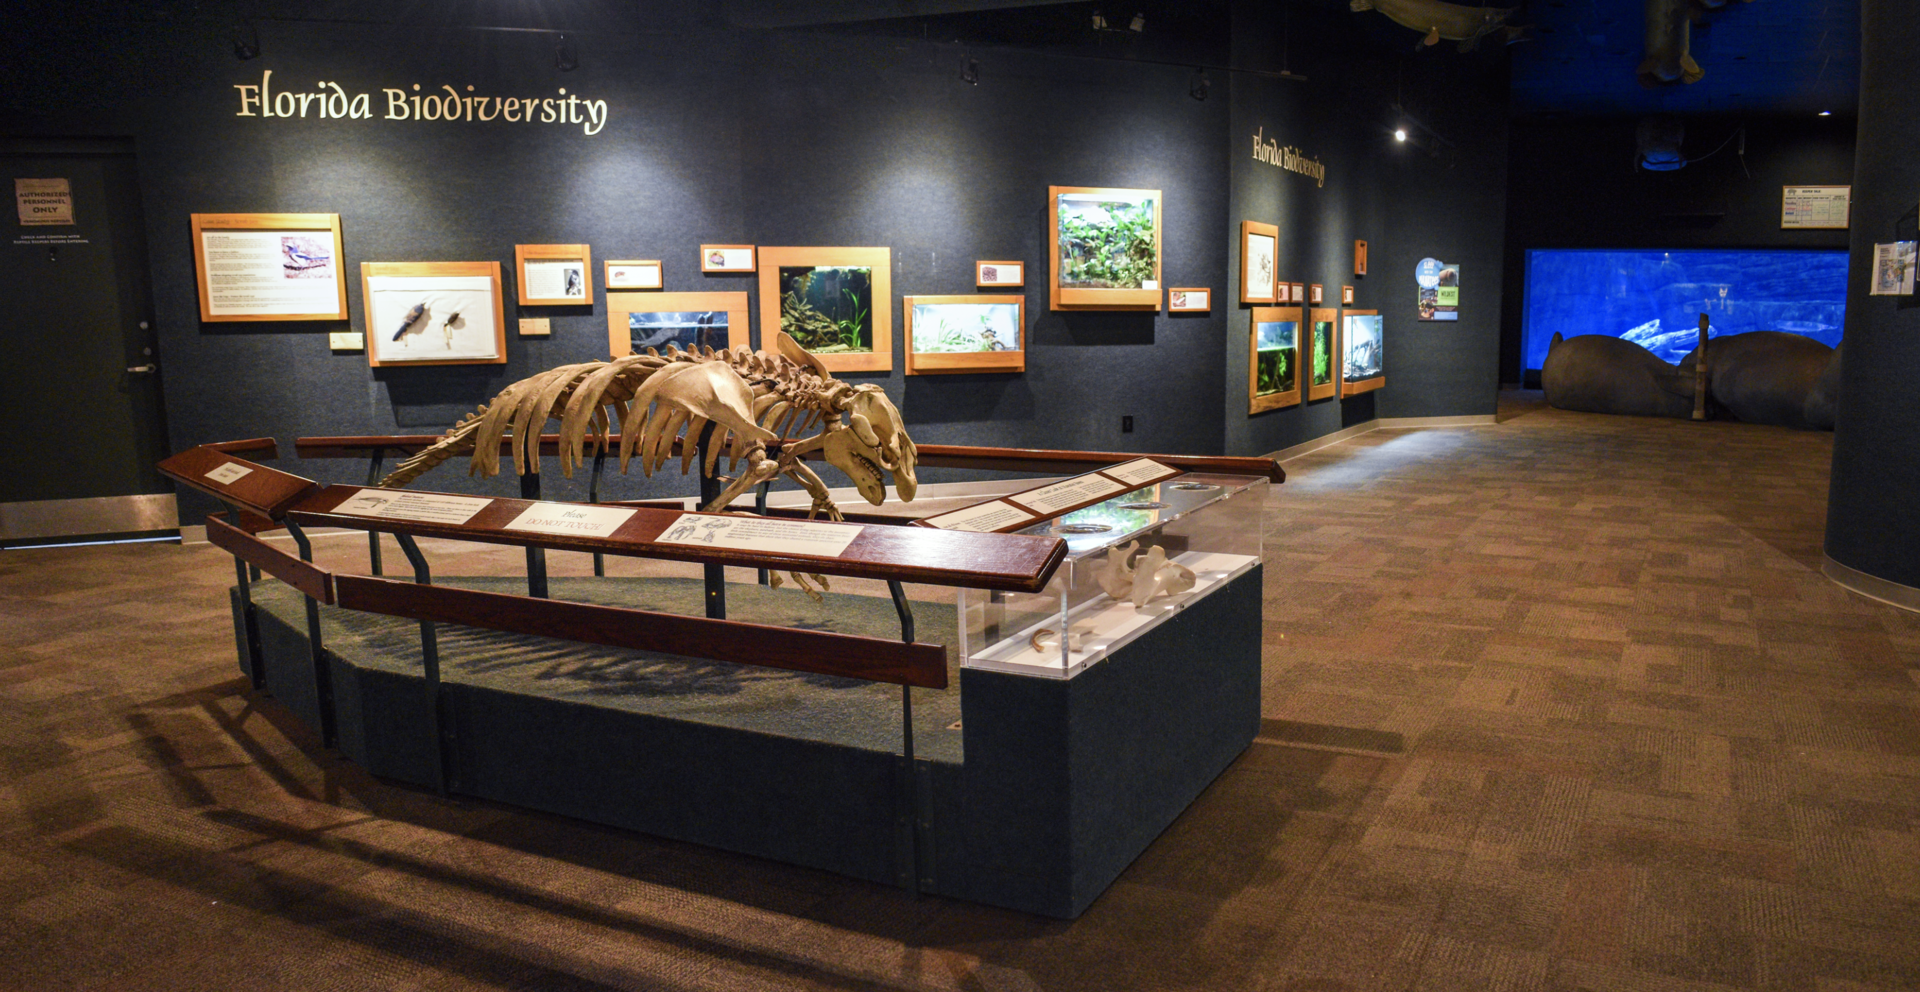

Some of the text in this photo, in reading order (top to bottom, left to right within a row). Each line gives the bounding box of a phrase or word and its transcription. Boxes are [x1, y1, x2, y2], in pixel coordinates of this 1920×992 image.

[233, 70, 609, 136] Florida Biodiversity
[1252, 126, 1325, 188] Florida Biodiversity
[525, 518, 604, 531] DO NOT TOUCH!
[561, 509, 587, 518] Please
